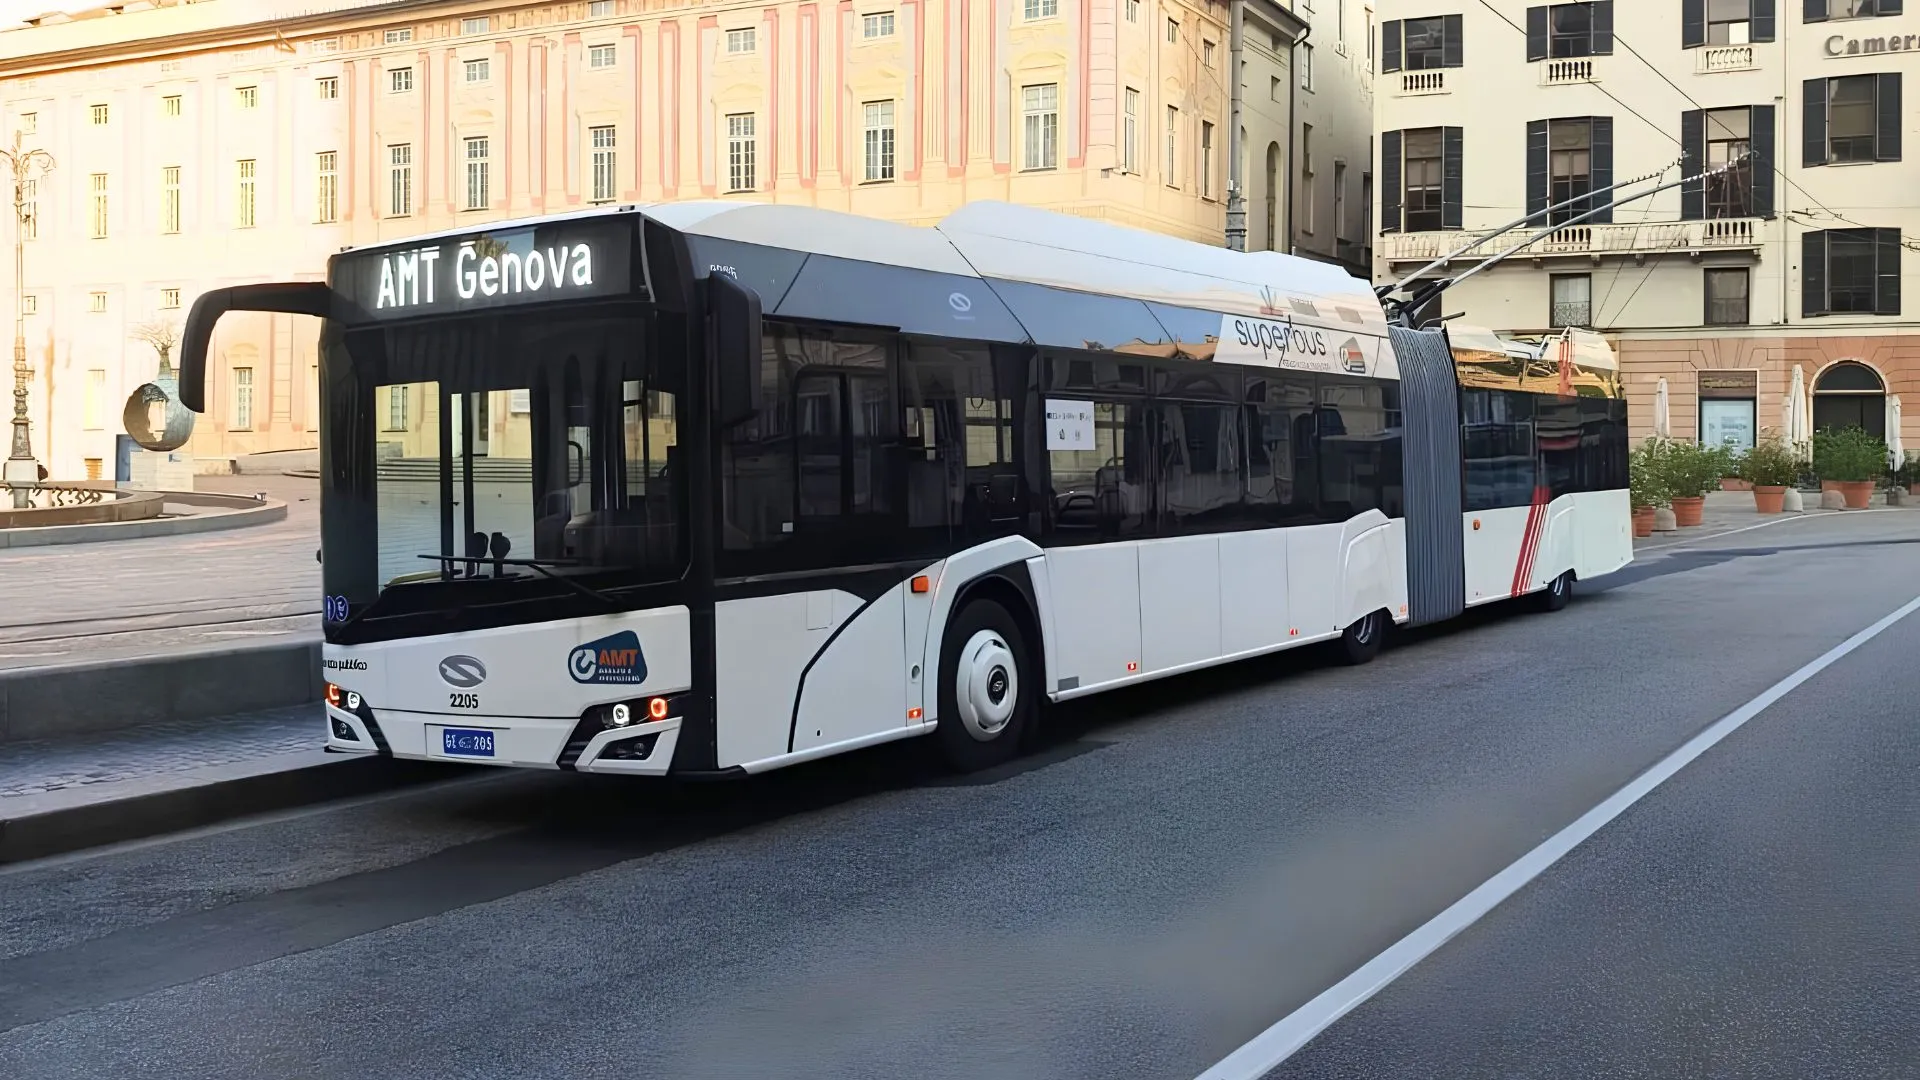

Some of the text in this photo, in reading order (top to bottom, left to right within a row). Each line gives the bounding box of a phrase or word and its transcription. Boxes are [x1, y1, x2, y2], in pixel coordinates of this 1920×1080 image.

[1824, 34, 1920, 56] Camer
[377, 241, 593, 310] AMT Genova
[1234, 314, 1327, 361] superbus
[599, 648, 638, 667] AMT
[449, 693, 479, 709] 2205
